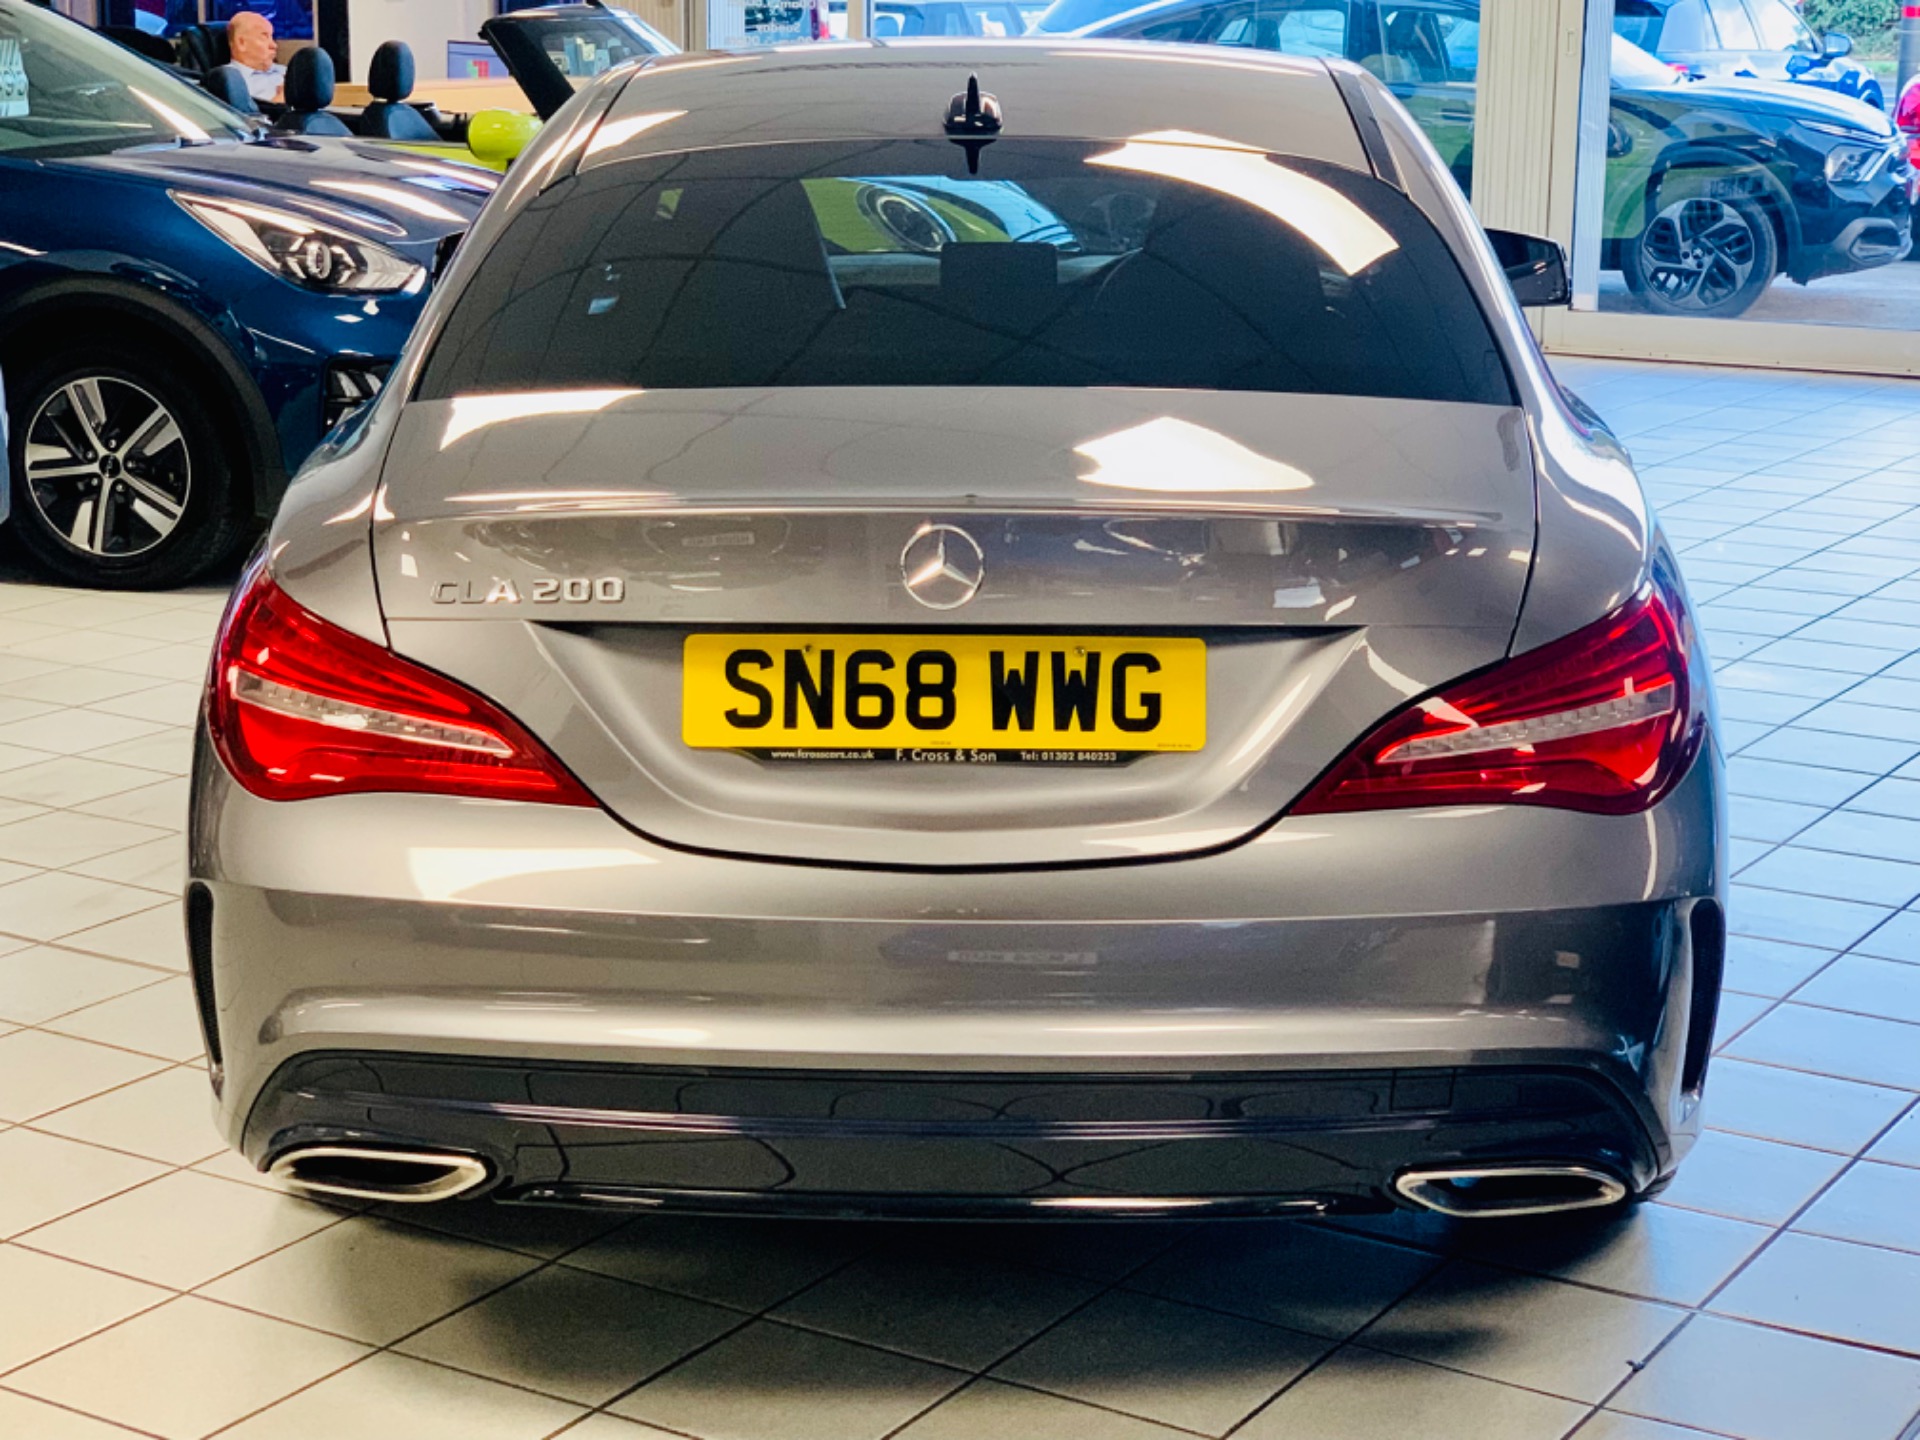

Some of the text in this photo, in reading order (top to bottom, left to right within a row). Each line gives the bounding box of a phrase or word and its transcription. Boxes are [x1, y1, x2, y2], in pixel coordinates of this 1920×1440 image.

[430, 576, 625, 604] CLA 200
[724, 649, 1161, 732] SN68 WWG
[912, 748, 950, 761] Cross
[955, 749, 966, 761] &
[970, 749, 997, 761] Son
[1021, 752, 1117, 761] Tel: 01302 840253
